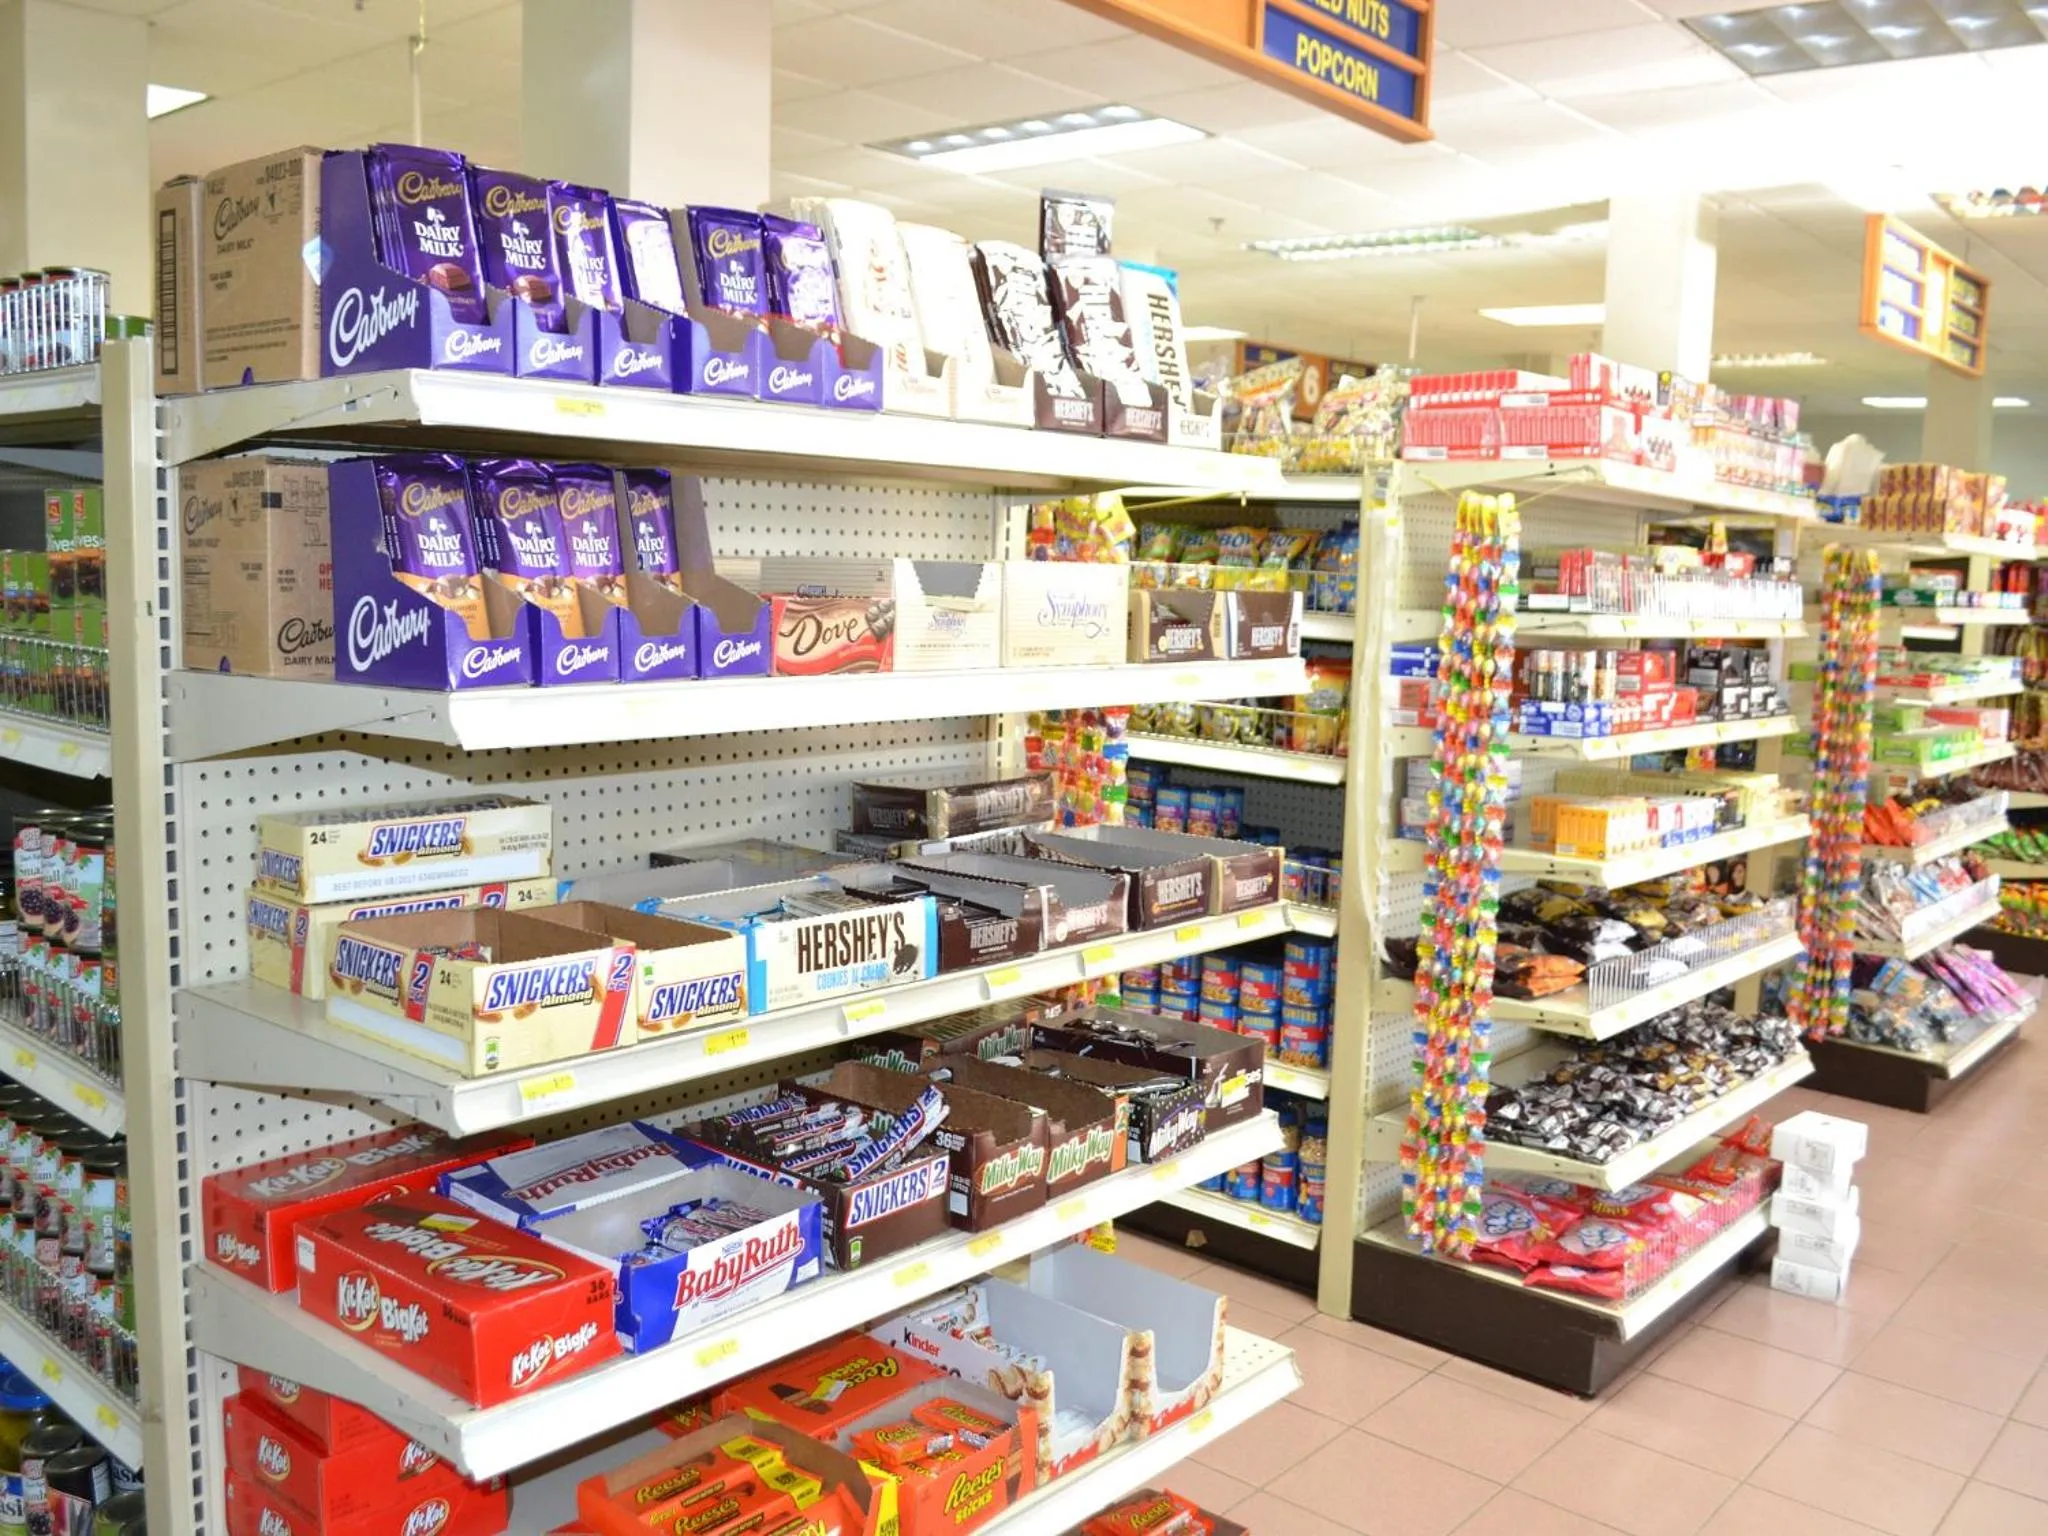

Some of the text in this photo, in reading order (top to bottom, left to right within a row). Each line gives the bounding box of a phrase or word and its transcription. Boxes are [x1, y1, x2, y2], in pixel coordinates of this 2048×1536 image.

[1346, 0, 1390, 38] NUTS
[1296, 32, 1379, 100] POPCORN
[398, 171, 463, 205] Cadbury
[486, 185, 546, 218] Cadbury
[413, 221, 461, 242] DAIRY
[501, 233, 543, 255] DAIRY
[708, 228, 760, 258] Cadbury
[419, 240, 464, 257] MILK
[505, 250, 546, 270] MILK
[720, 272, 756, 290] DAIRY
[723, 286, 758, 304] MILK
[330, 287, 418, 368] Cadbury
[443, 330, 501, 362] Cadbury
[530, 341, 583, 367] Cadbury
[614, 349, 663, 378] Cadbury
[704, 358, 749, 386] Cadbury
[769, 366, 813, 394] Cadbury
[834, 374, 875, 401] Cadbury
[402, 483, 463, 516] Cadbury
[500, 484, 556, 519] Cadbury
[560, 487, 614, 520] Cadbury
[418, 534, 461, 551] DAIRY
[516, 535, 556, 553] DAIRY
[572, 535, 611, 552] DAIRY
[637, 535, 667, 552] AIRY
[423, 549, 464, 567] MILK
[520, 550, 560, 568] MILK
[575, 551, 614, 566] MILK
[1038, 590, 1113, 640] Symphony
[277, 617, 335, 654] Cadbu
[350, 595, 430, 673] Cadbury
[779, 613, 866, 656] Dove
[1165, 626, 1203, 650] HERSHEY'S
[1251, 625, 1284, 648] HERSHEY'S
[284, 656, 312, 666] DAIRY
[463, 646, 521, 678] Cadbury
[556, 644, 609, 675] Cadbury
[634, 641, 686, 672] Cadbury
[713, 639, 762, 668] Cadbury
[310, 831, 328, 845] 24
[370, 818, 465, 857] SNICKERS
[262, 851, 300, 882] SNICKERS
[518, 890, 533, 902] 24
[1157, 872, 1203, 904] HERSHEY'S
[1236, 875, 1268, 898] HERSHEY'S
[250, 899, 290, 935] SNICKERS
[296, 916, 307, 936] 2
[797, 911, 905, 974] HERSHEY'S
[970, 920, 1018, 949] HERSHEY'S
[336, 938, 401, 989] SNICKERS
[413, 963, 428, 990] 2
[613, 955, 632, 980] 2
[440, 970, 451, 986] 24
[488, 960, 594, 1009] SNICKERS
[816, 970, 849, 991] COOKIES
[541, 987, 594, 1008] Almond
[651, 973, 742, 1020] SNICKERS
[696, 999, 741, 1017] Almond
[850, 1104, 924, 1176] SNICKERS
[935, 1130, 951, 1146] 36
[850, 1166, 929, 1227] SNICKERS
[934, 1160, 946, 1184] 2
[590, 1278, 606, 1294] 36
[903, 1325, 942, 1357] kinder
